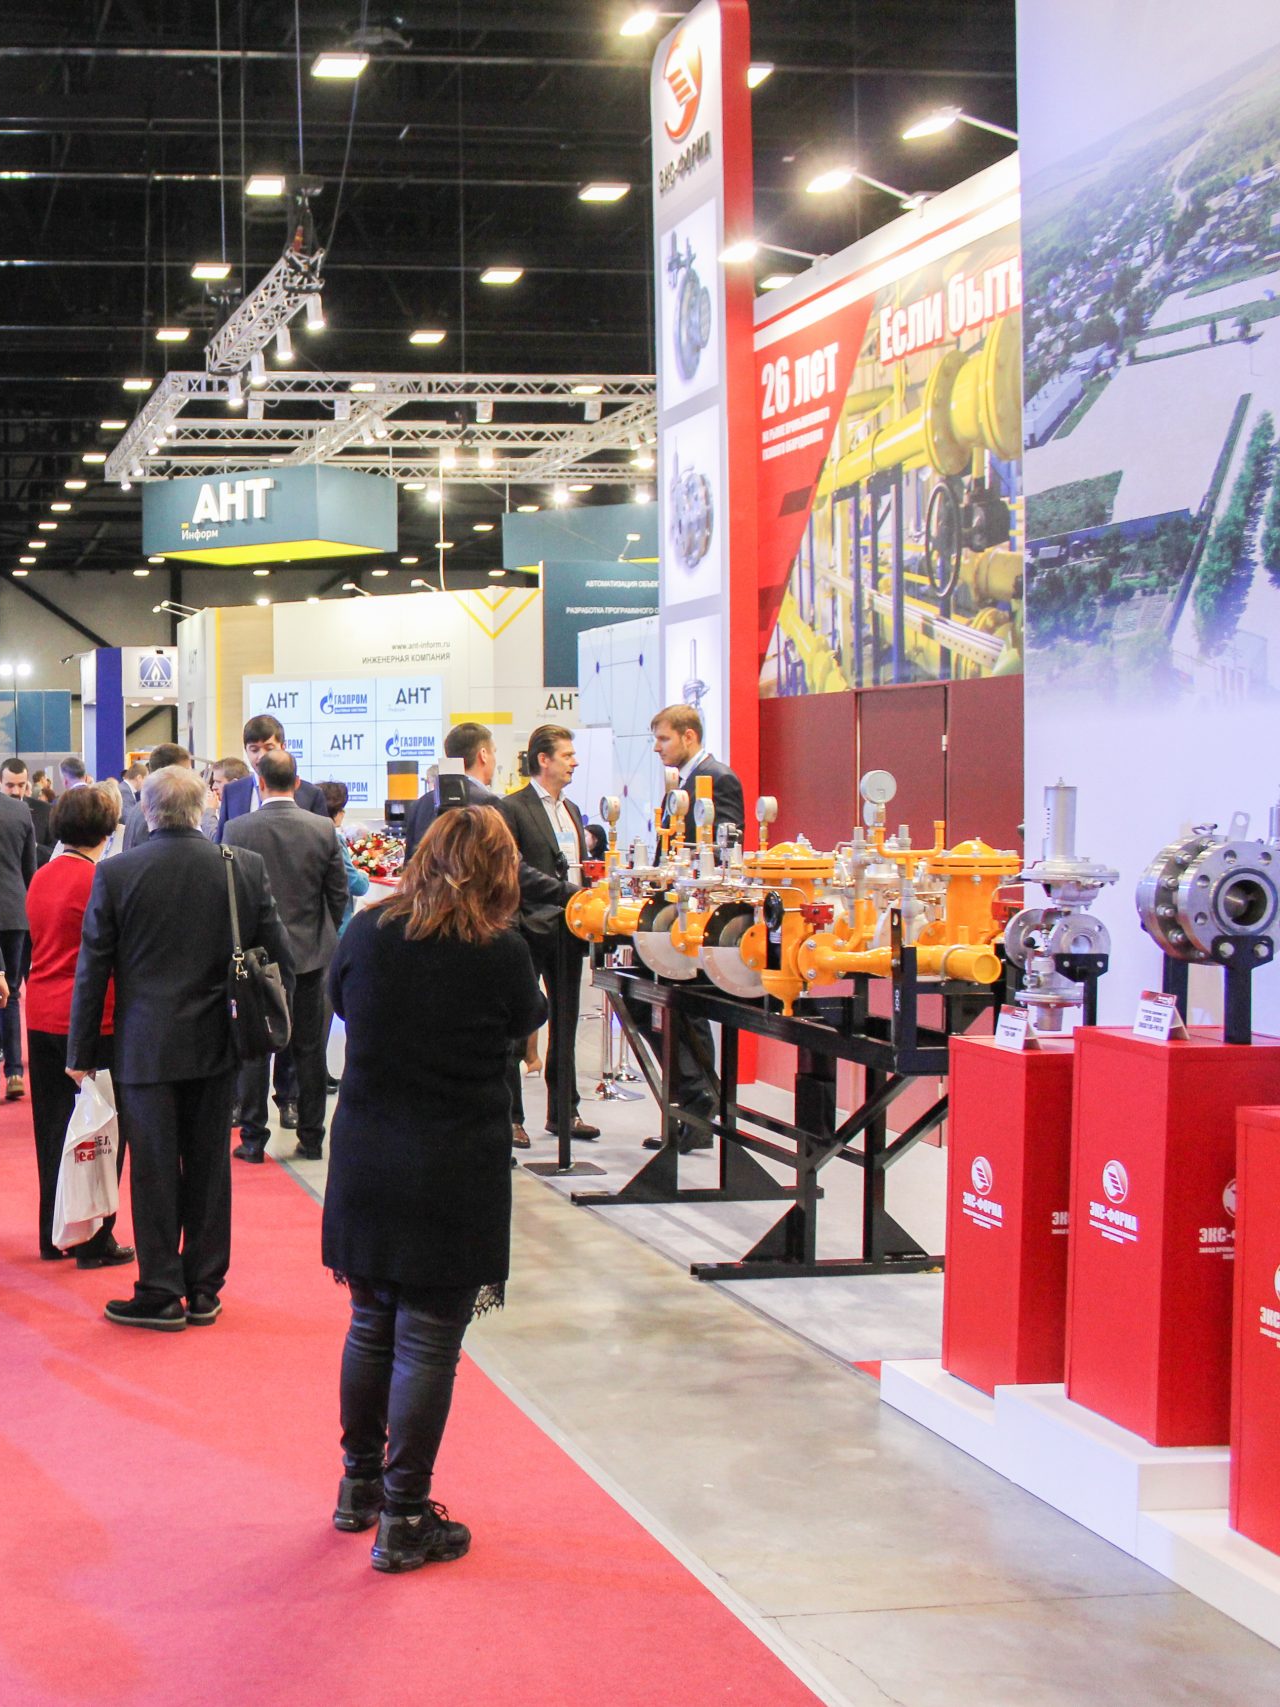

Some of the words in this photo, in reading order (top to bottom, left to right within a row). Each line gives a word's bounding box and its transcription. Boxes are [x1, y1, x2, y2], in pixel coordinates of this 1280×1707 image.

[880, 291, 944, 365] Если
[761, 356, 790, 420] 26
[794, 342, 839, 407] лет
[192, 478, 274, 524] АНТ
[181, 529, 219, 541] Информ
[362, 654, 410, 664] ИНЖЕНЕРНАЯ
[411, 652, 451, 662] КОМПАНИЯ
[266, 692, 299, 709] АНТ
[334, 694, 368, 704] ГАЗПРОМ
[395, 687, 431, 705] АНТ
[330, 734, 364, 750] АНТ
[401, 736, 435, 747] ГАЗПРОМ
[962, 1191, 1003, 1219] ЭКС-ФОРМА
[1089, 1201, 1139, 1232] ЭКС-ФОРМА
